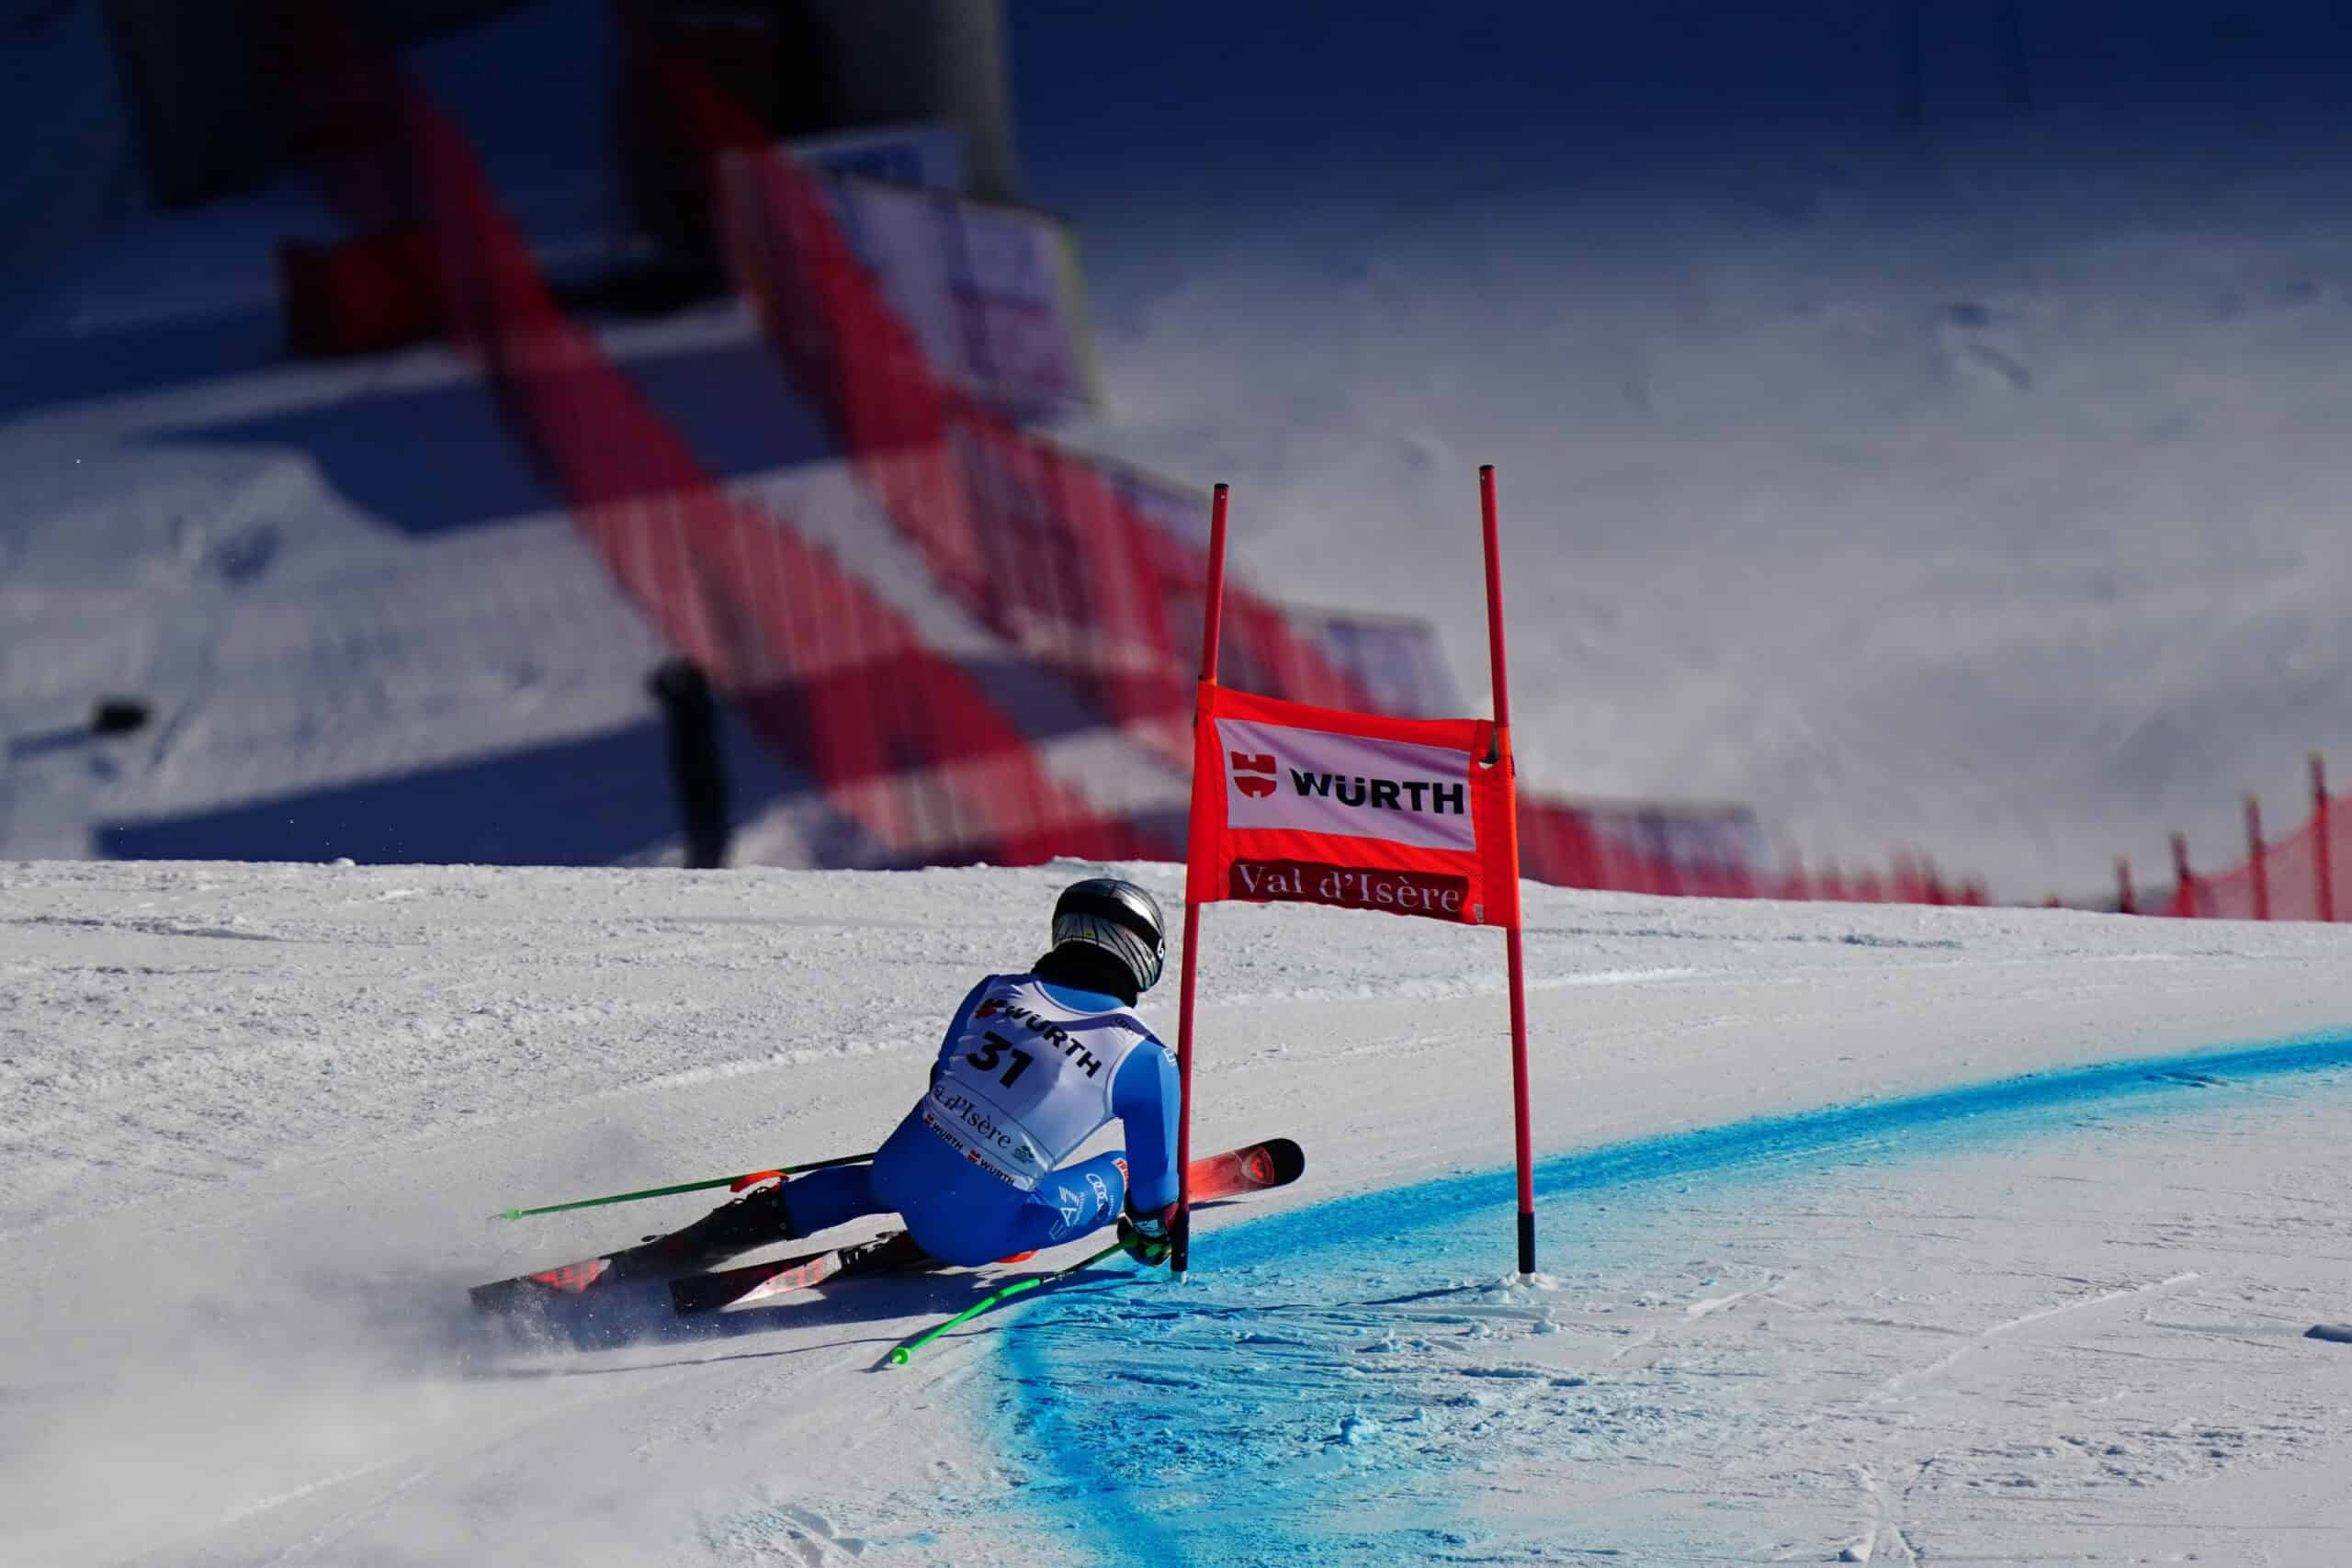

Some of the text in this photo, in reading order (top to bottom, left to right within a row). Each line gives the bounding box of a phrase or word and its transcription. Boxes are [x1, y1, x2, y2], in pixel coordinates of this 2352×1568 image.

[1289, 767, 1464, 815] WÜRTH
[1235, 863, 1306, 895] Val
[967, 1031, 1035, 1089] 31
[1001, 1005, 1102, 1079] WÜRTH
